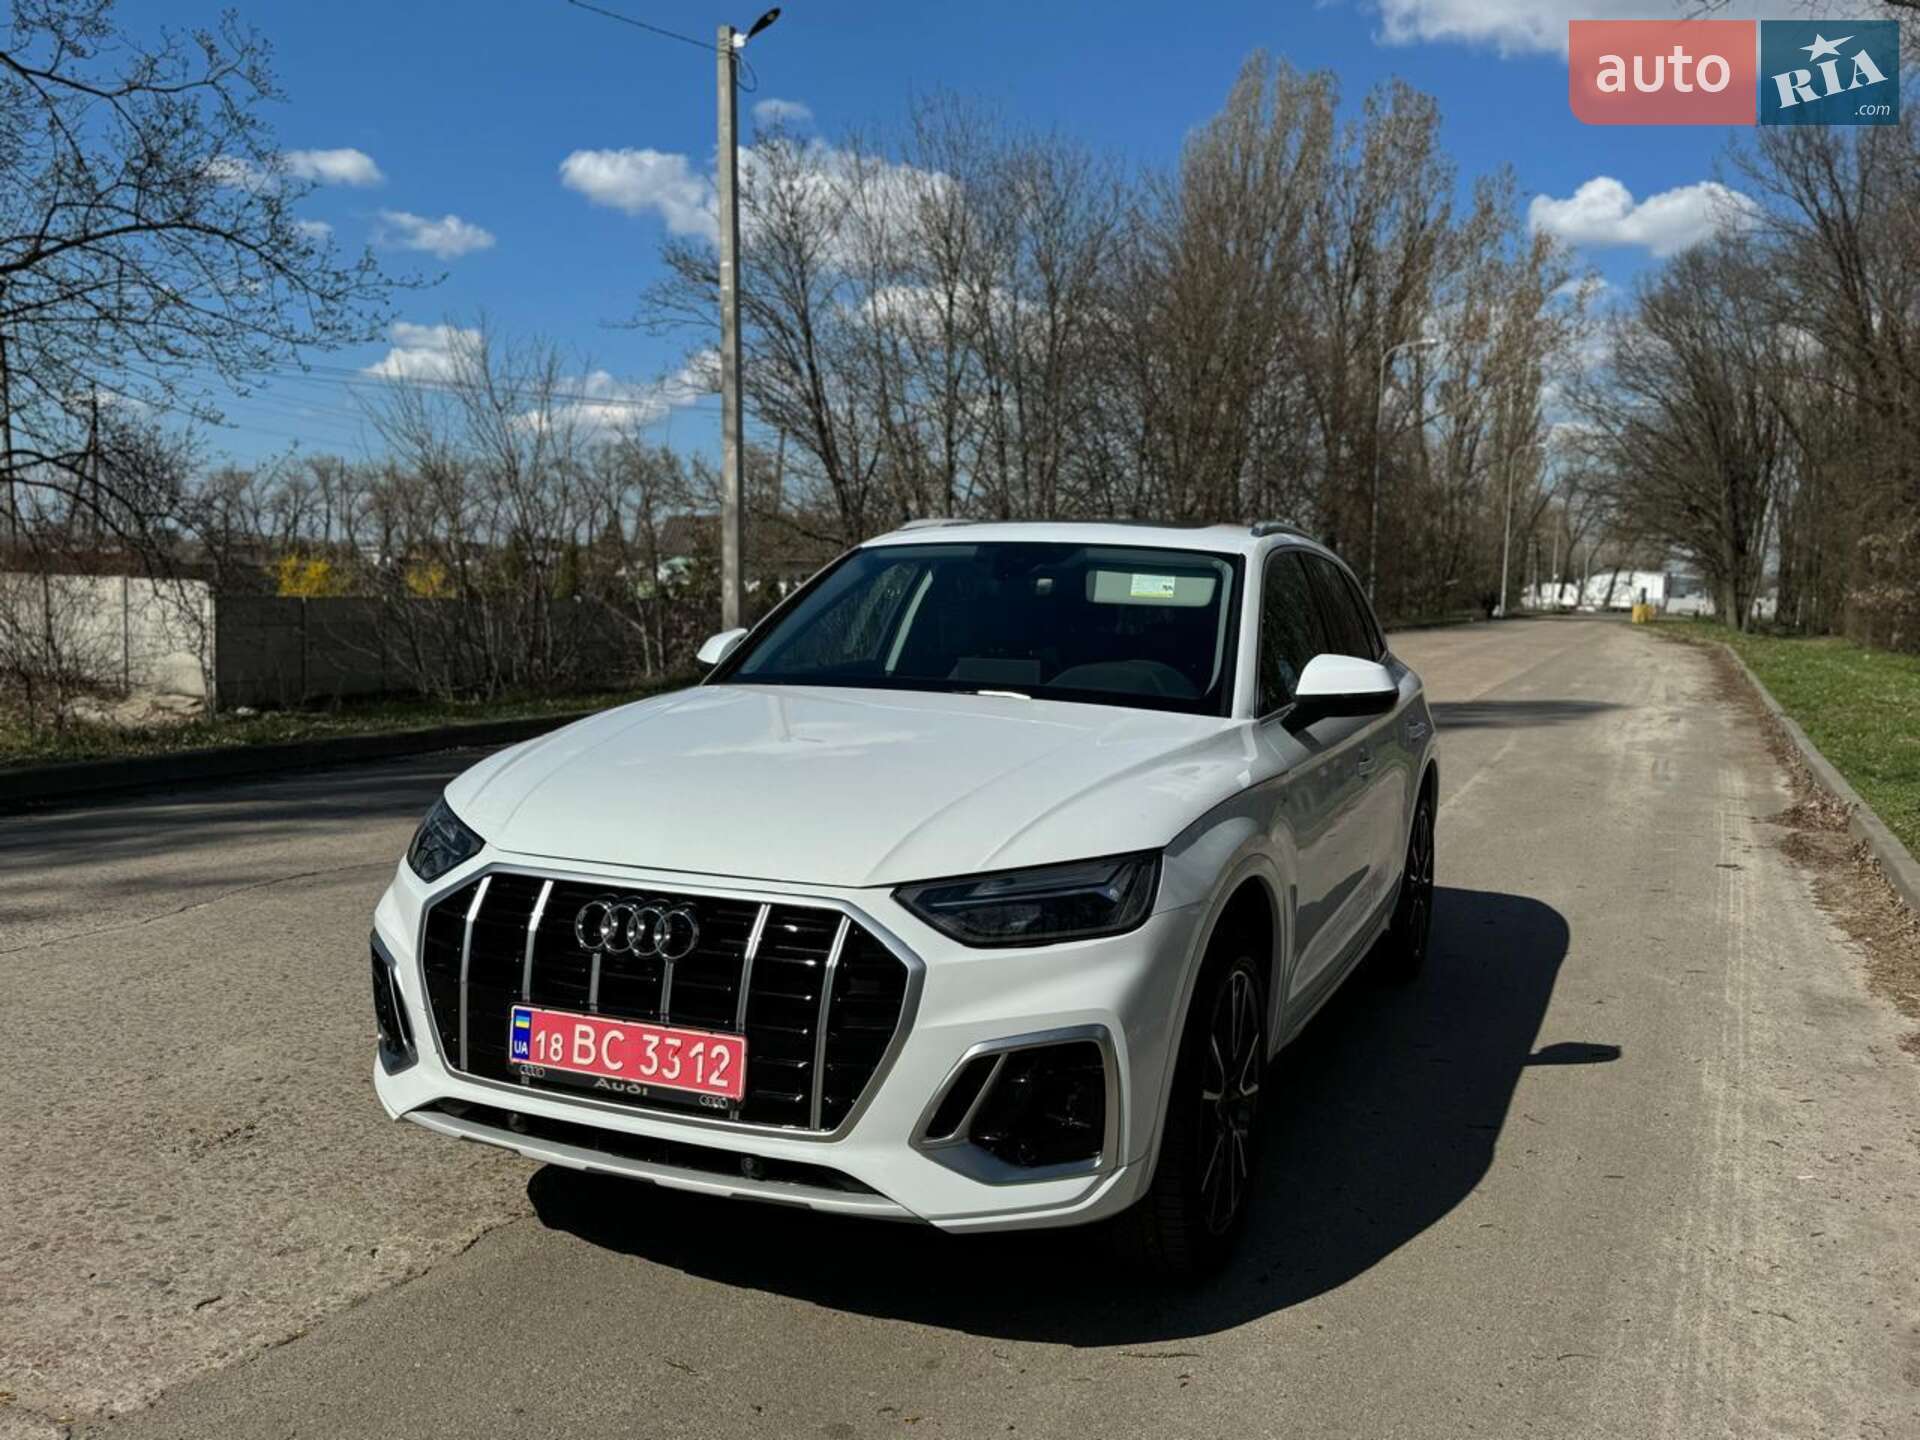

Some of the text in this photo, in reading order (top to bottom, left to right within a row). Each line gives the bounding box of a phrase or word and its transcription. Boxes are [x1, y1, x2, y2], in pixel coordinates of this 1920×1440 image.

[514, 1041, 528, 1054] UA
[535, 1024, 731, 1087] 18 BC 3312
[593, 1078, 649, 1096] Audi
